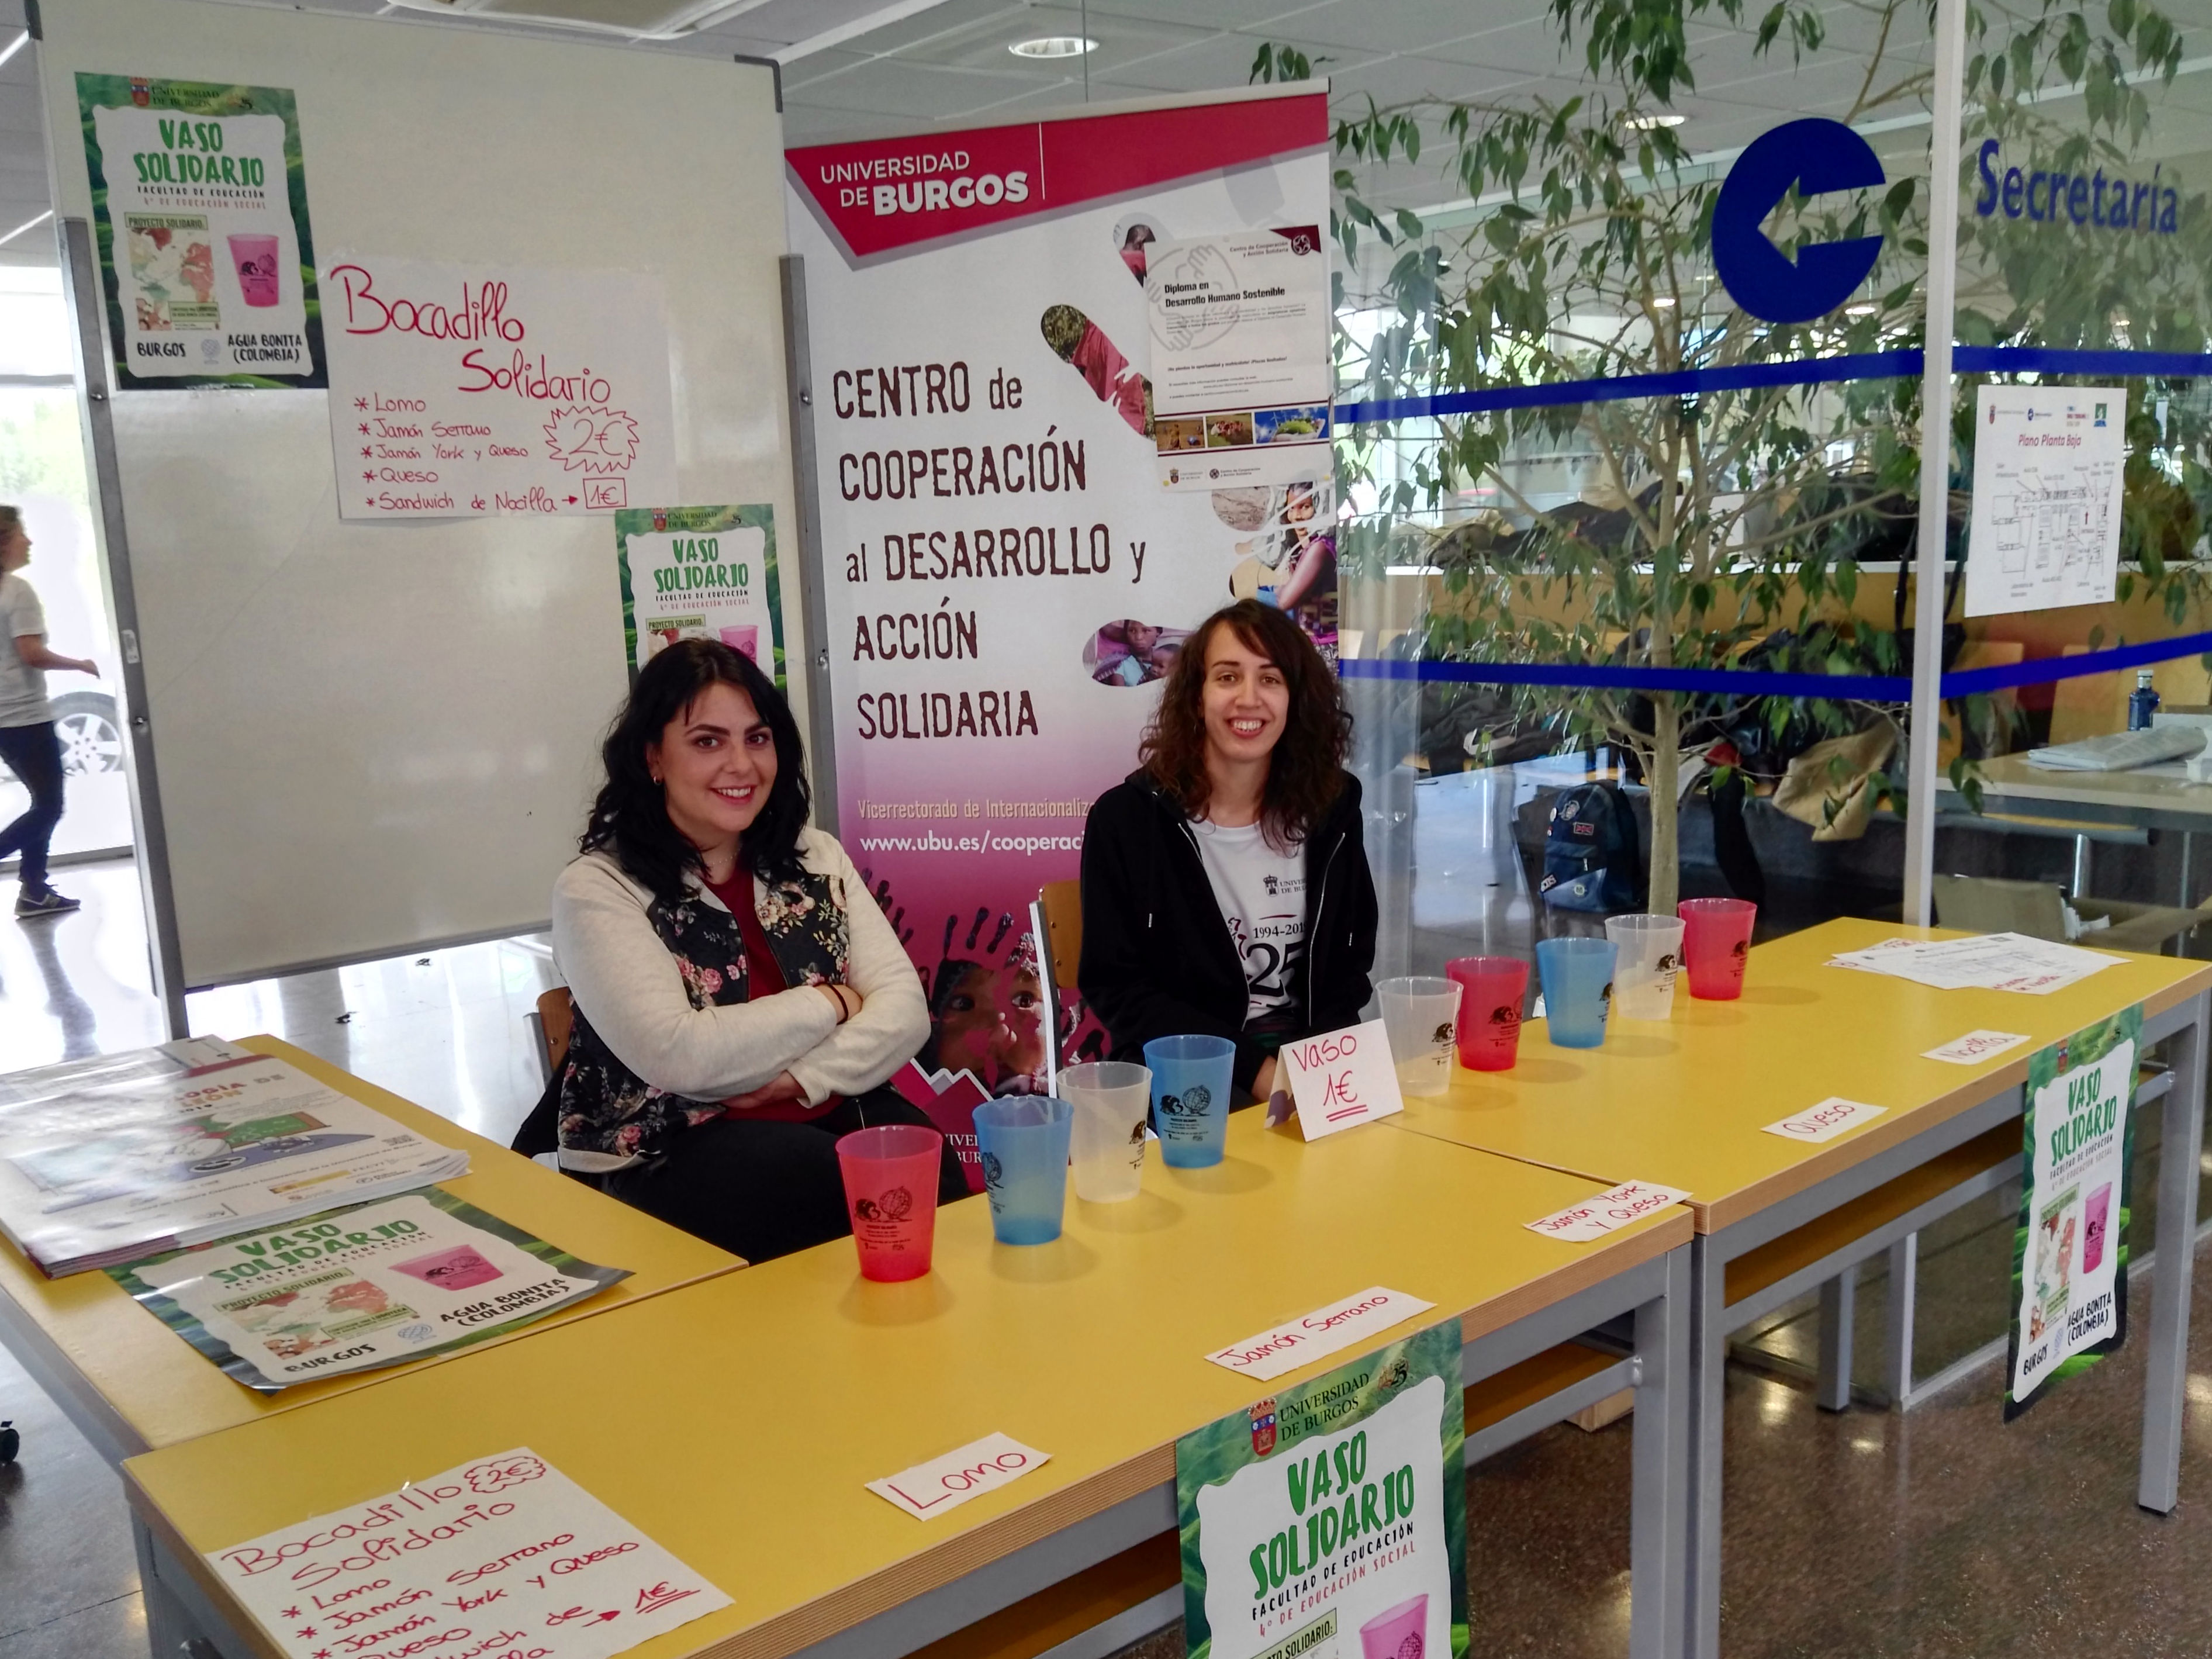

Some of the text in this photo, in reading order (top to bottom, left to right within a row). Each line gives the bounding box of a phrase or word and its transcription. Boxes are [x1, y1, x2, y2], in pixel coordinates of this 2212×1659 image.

[159, 119, 223, 153] VASO
[133, 153, 264, 187] SOLIDARIO
[821, 150, 970, 184] UNIVERSIDAD
[1976, 138, 2178, 234] Secretaría
[137, 186, 265, 199] FACULTAD DE EDUCACIÓN
[840, 171, 1029, 216] DE BURGOS
[128, 217, 165, 228] PROYECTO
[330, 264, 524, 342] Bocadillo
[1164, 282, 1209, 295] Diploma en
[1165, 287, 1285, 308] Desarrollo Humano Sostenible
[137, 342, 186, 358] BURGOS
[228, 334, 302, 348] AGUA BONITA
[233, 348, 300, 364] (COLOMBIA)
[458, 348, 611, 403] Solidario
[834, 361, 1022, 419] CENTRO de
[374, 392, 426, 413] Lomo
[373, 417, 492, 439] Jamón Serrano
[567, 418, 623, 457] 2€
[2018, 433, 2082, 449] Plano Planta Baja
[376, 444, 528, 462] Jamón York y Queso
[839, 425, 1086, 502] COOPERACIÓN
[380, 466, 438, 484] Queso
[378, 484, 619, 513] Sandwich de Nocilla 1€
[672, 537, 719, 564] VASO
[846, 523, 1146, 583] al DESARROLLO y
[654, 563, 749, 593] SOLIDARIO
[655, 593, 692, 602] FACULTAD
[707, 589, 749, 599] EDUCACIÓN
[648, 620, 675, 629] PROYECTO
[853, 596, 978, 661] ACCIÓN
[857, 690, 1039, 740] SOLIDARIA
[858, 799, 958, 819] Vicerrectorado
[963, 799, 980, 818] de
[1323, 1070, 1358, 1106] 1€
[2068, 1067, 2102, 1116] VASO
[1783, 1104, 1855, 1134] Queso
[2051, 1095, 2117, 1167] SOLIDARIO
[1531, 1186, 1646, 1231] Jamón York
[1608, 1194, 1669, 1219] Queso
[208, 1219, 419, 1284] SOLIDARIO
[236, 1223, 342, 1256] VASO
[225, 1231, 427, 1290] FACULTAD DE EDUCACIÓN
[221, 1288, 281, 1311] PROYECTO
[439, 1278, 566, 1323] AGUA BONITA
[457, 1285, 571, 1326] (COLOMBIA)
[2067, 1304, 2085, 1330] AGUA
[2086, 1291, 2112, 1315] BONITA
[1216, 1296, 1389, 1367] Jamón Serrano
[2067, 1309, 2109, 1347] (COLOMBIA)
[284, 1344, 377, 1373] BURGOS
[2023, 1343, 2048, 1376] BURGOS
[1280, 1373, 1370, 1422] UNIVERSIDAD
[1281, 1396, 1360, 1442] DE BURGOS
[887, 1453, 1027, 1510] Lomo
[1287, 1430, 1367, 1516] VASO
[220, 1461, 532, 1577] Bocadillo 2€
[1249, 1464, 1415, 1601] SOLIDARIO
[292, 1502, 516, 1591] Solidario
[323, 1533, 575, 1631] Jamón Serrano
[1252, 1522, 1414, 1621] FACULTAD DE EDUCACIÓN
[1280, 1608, 1293, 1625] DE
[1300, 1565, 1366, 1612] EDUCACIÓN
[1373, 1540, 1416, 1572] SOCIAL
[311, 1578, 392, 1610] Lomo
[331, 1614, 437, 1653] Jamón
[441, 1588, 508, 1614] York
[550, 1542, 640, 1575] Queso
[546, 1606, 593, 1626] de
